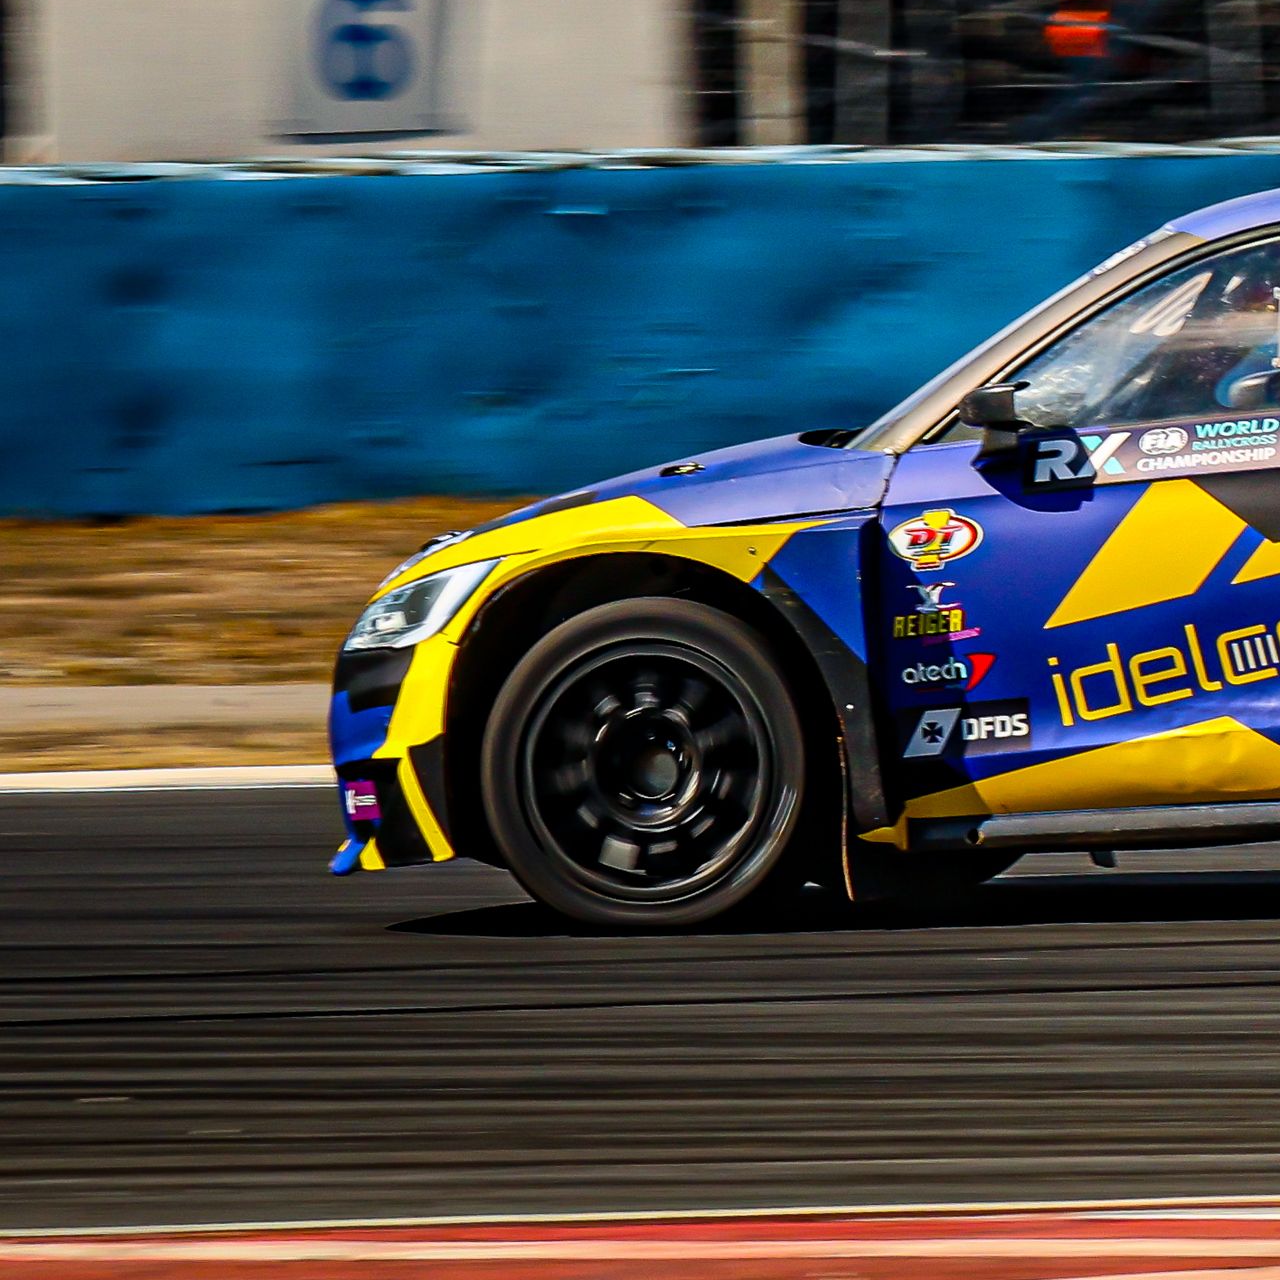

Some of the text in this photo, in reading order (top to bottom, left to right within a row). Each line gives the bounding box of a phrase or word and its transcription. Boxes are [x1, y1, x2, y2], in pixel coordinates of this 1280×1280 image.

[1191, 433, 1278, 451] RALLYCROSS
[1194, 418, 1280, 439] WORLD
[1033, 431, 1132, 483] RX
[1136, 447, 1277, 472] CHAMPIONSHIP
[904, 523, 964, 550] DT
[893, 608, 964, 638] REIGER
[901, 656, 968, 684] atech
[961, 713, 1031, 741] DFDS
